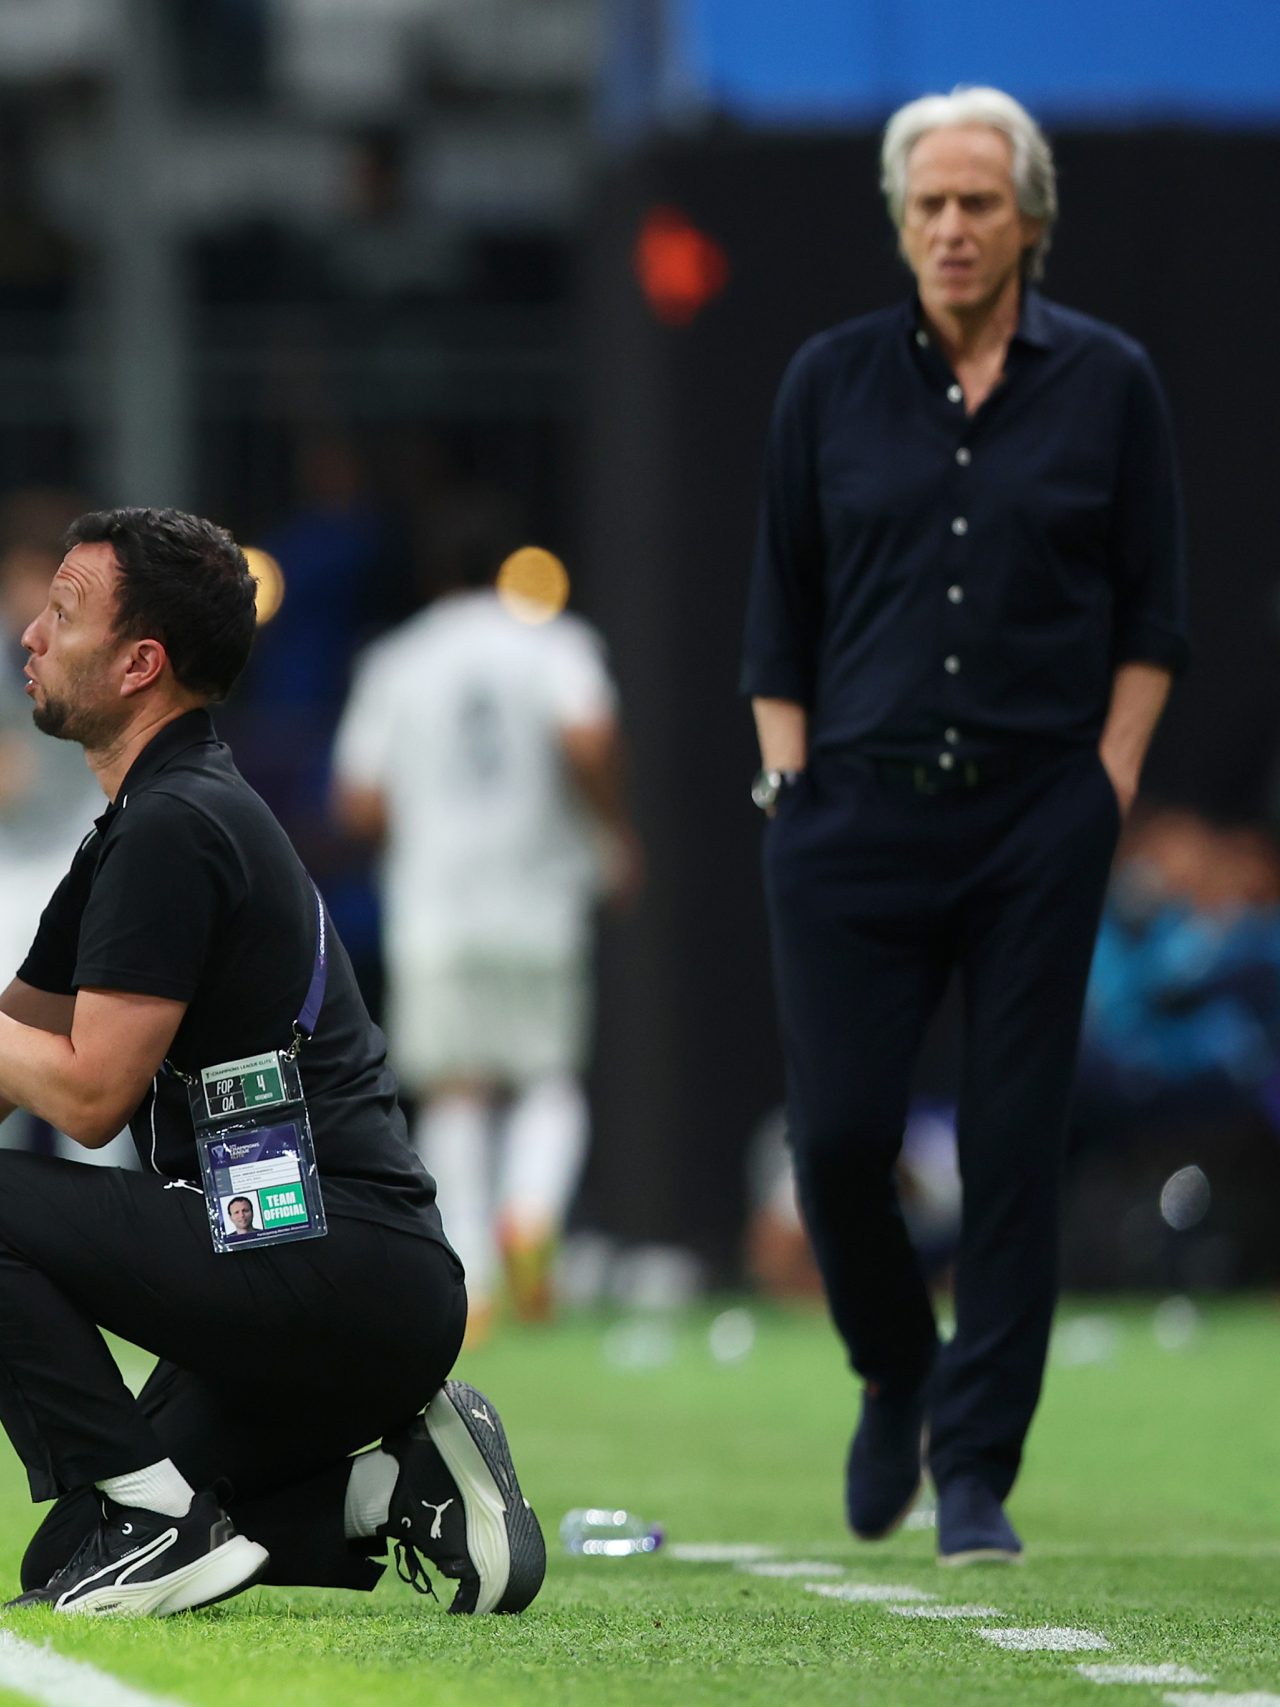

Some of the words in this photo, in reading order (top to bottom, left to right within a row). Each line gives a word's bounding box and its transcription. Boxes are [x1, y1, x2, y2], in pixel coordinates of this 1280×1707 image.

[217, 1079, 234, 1095] FOP
[256, 1074, 266, 1092] 4
[222, 1096, 235, 1111] OA
[266, 1191, 296, 1208] TEAM
[263, 1203, 305, 1221] OFFICIAL
